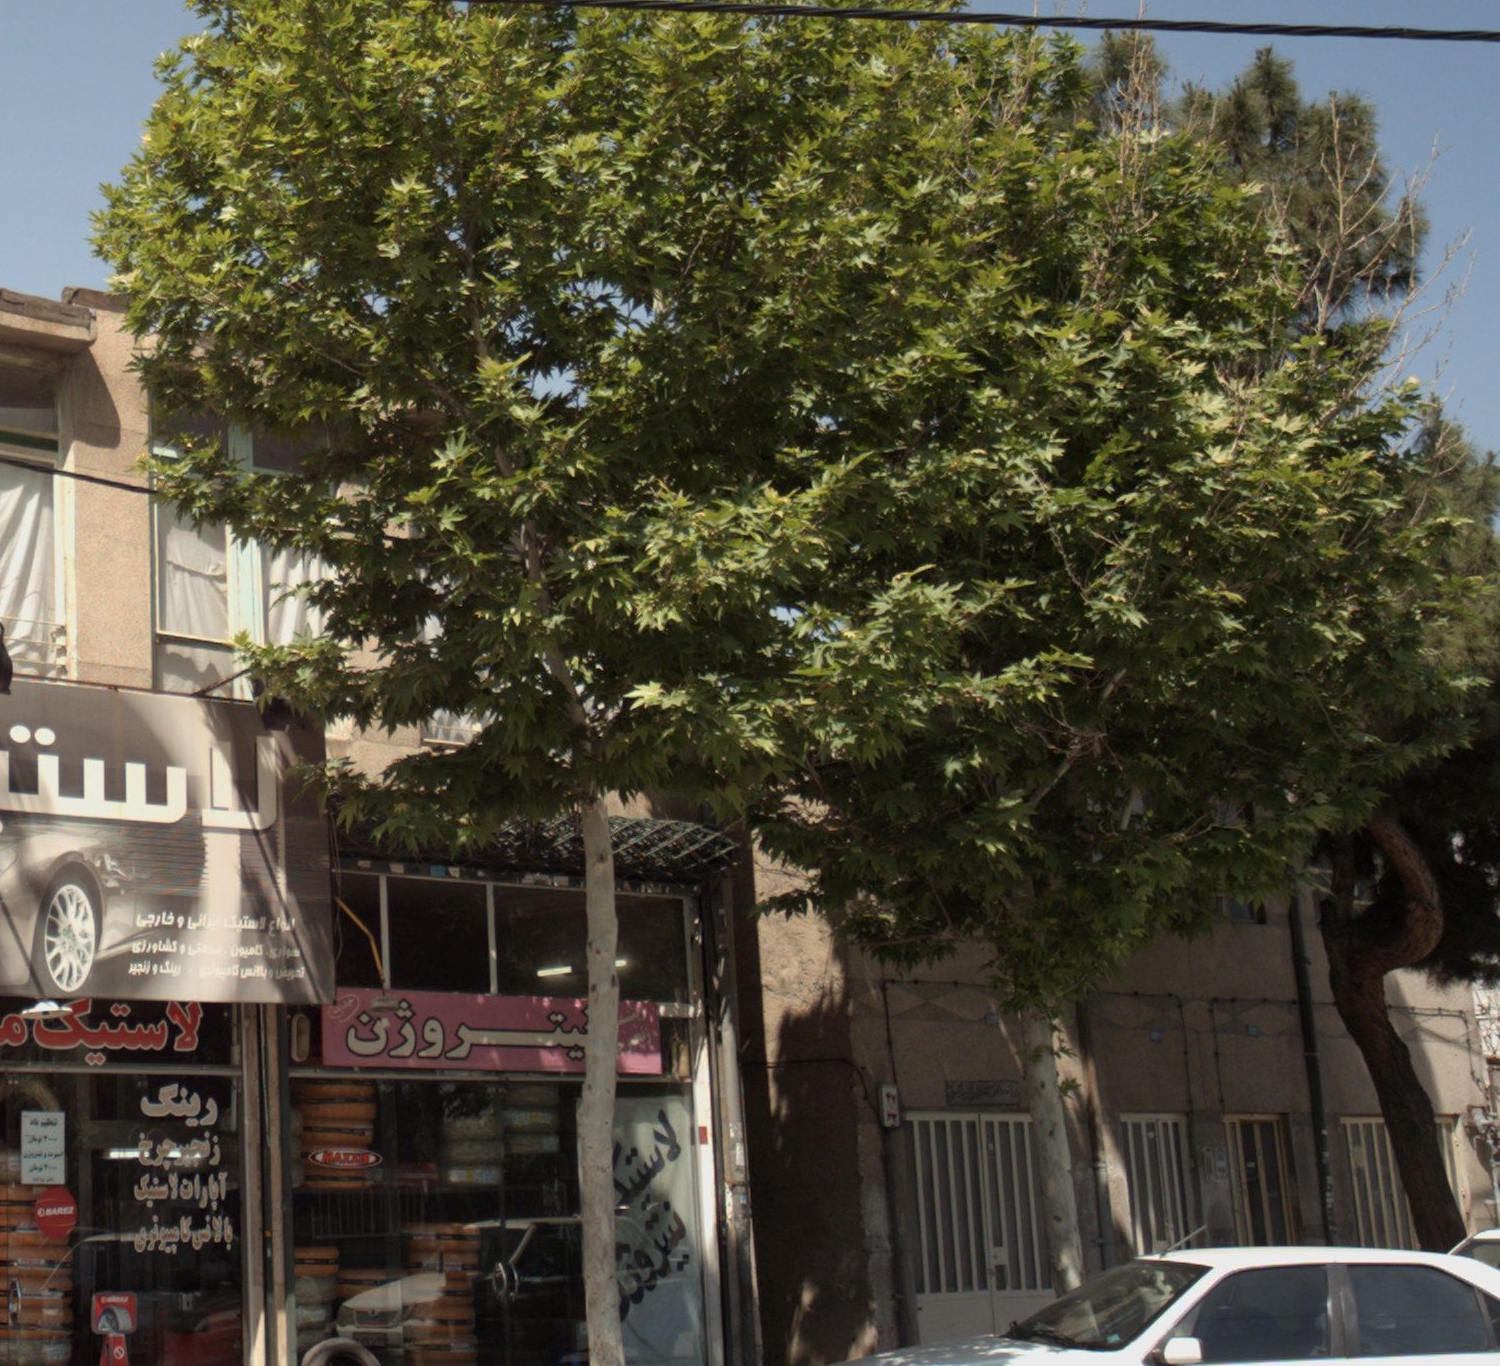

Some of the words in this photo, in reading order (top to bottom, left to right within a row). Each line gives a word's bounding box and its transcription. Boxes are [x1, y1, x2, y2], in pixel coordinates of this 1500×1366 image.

[33, 998, 203, 1065] لاستیک
[346, 998, 590, 1060] یتروژن
[140, 1083, 218, 1127] رینگ
